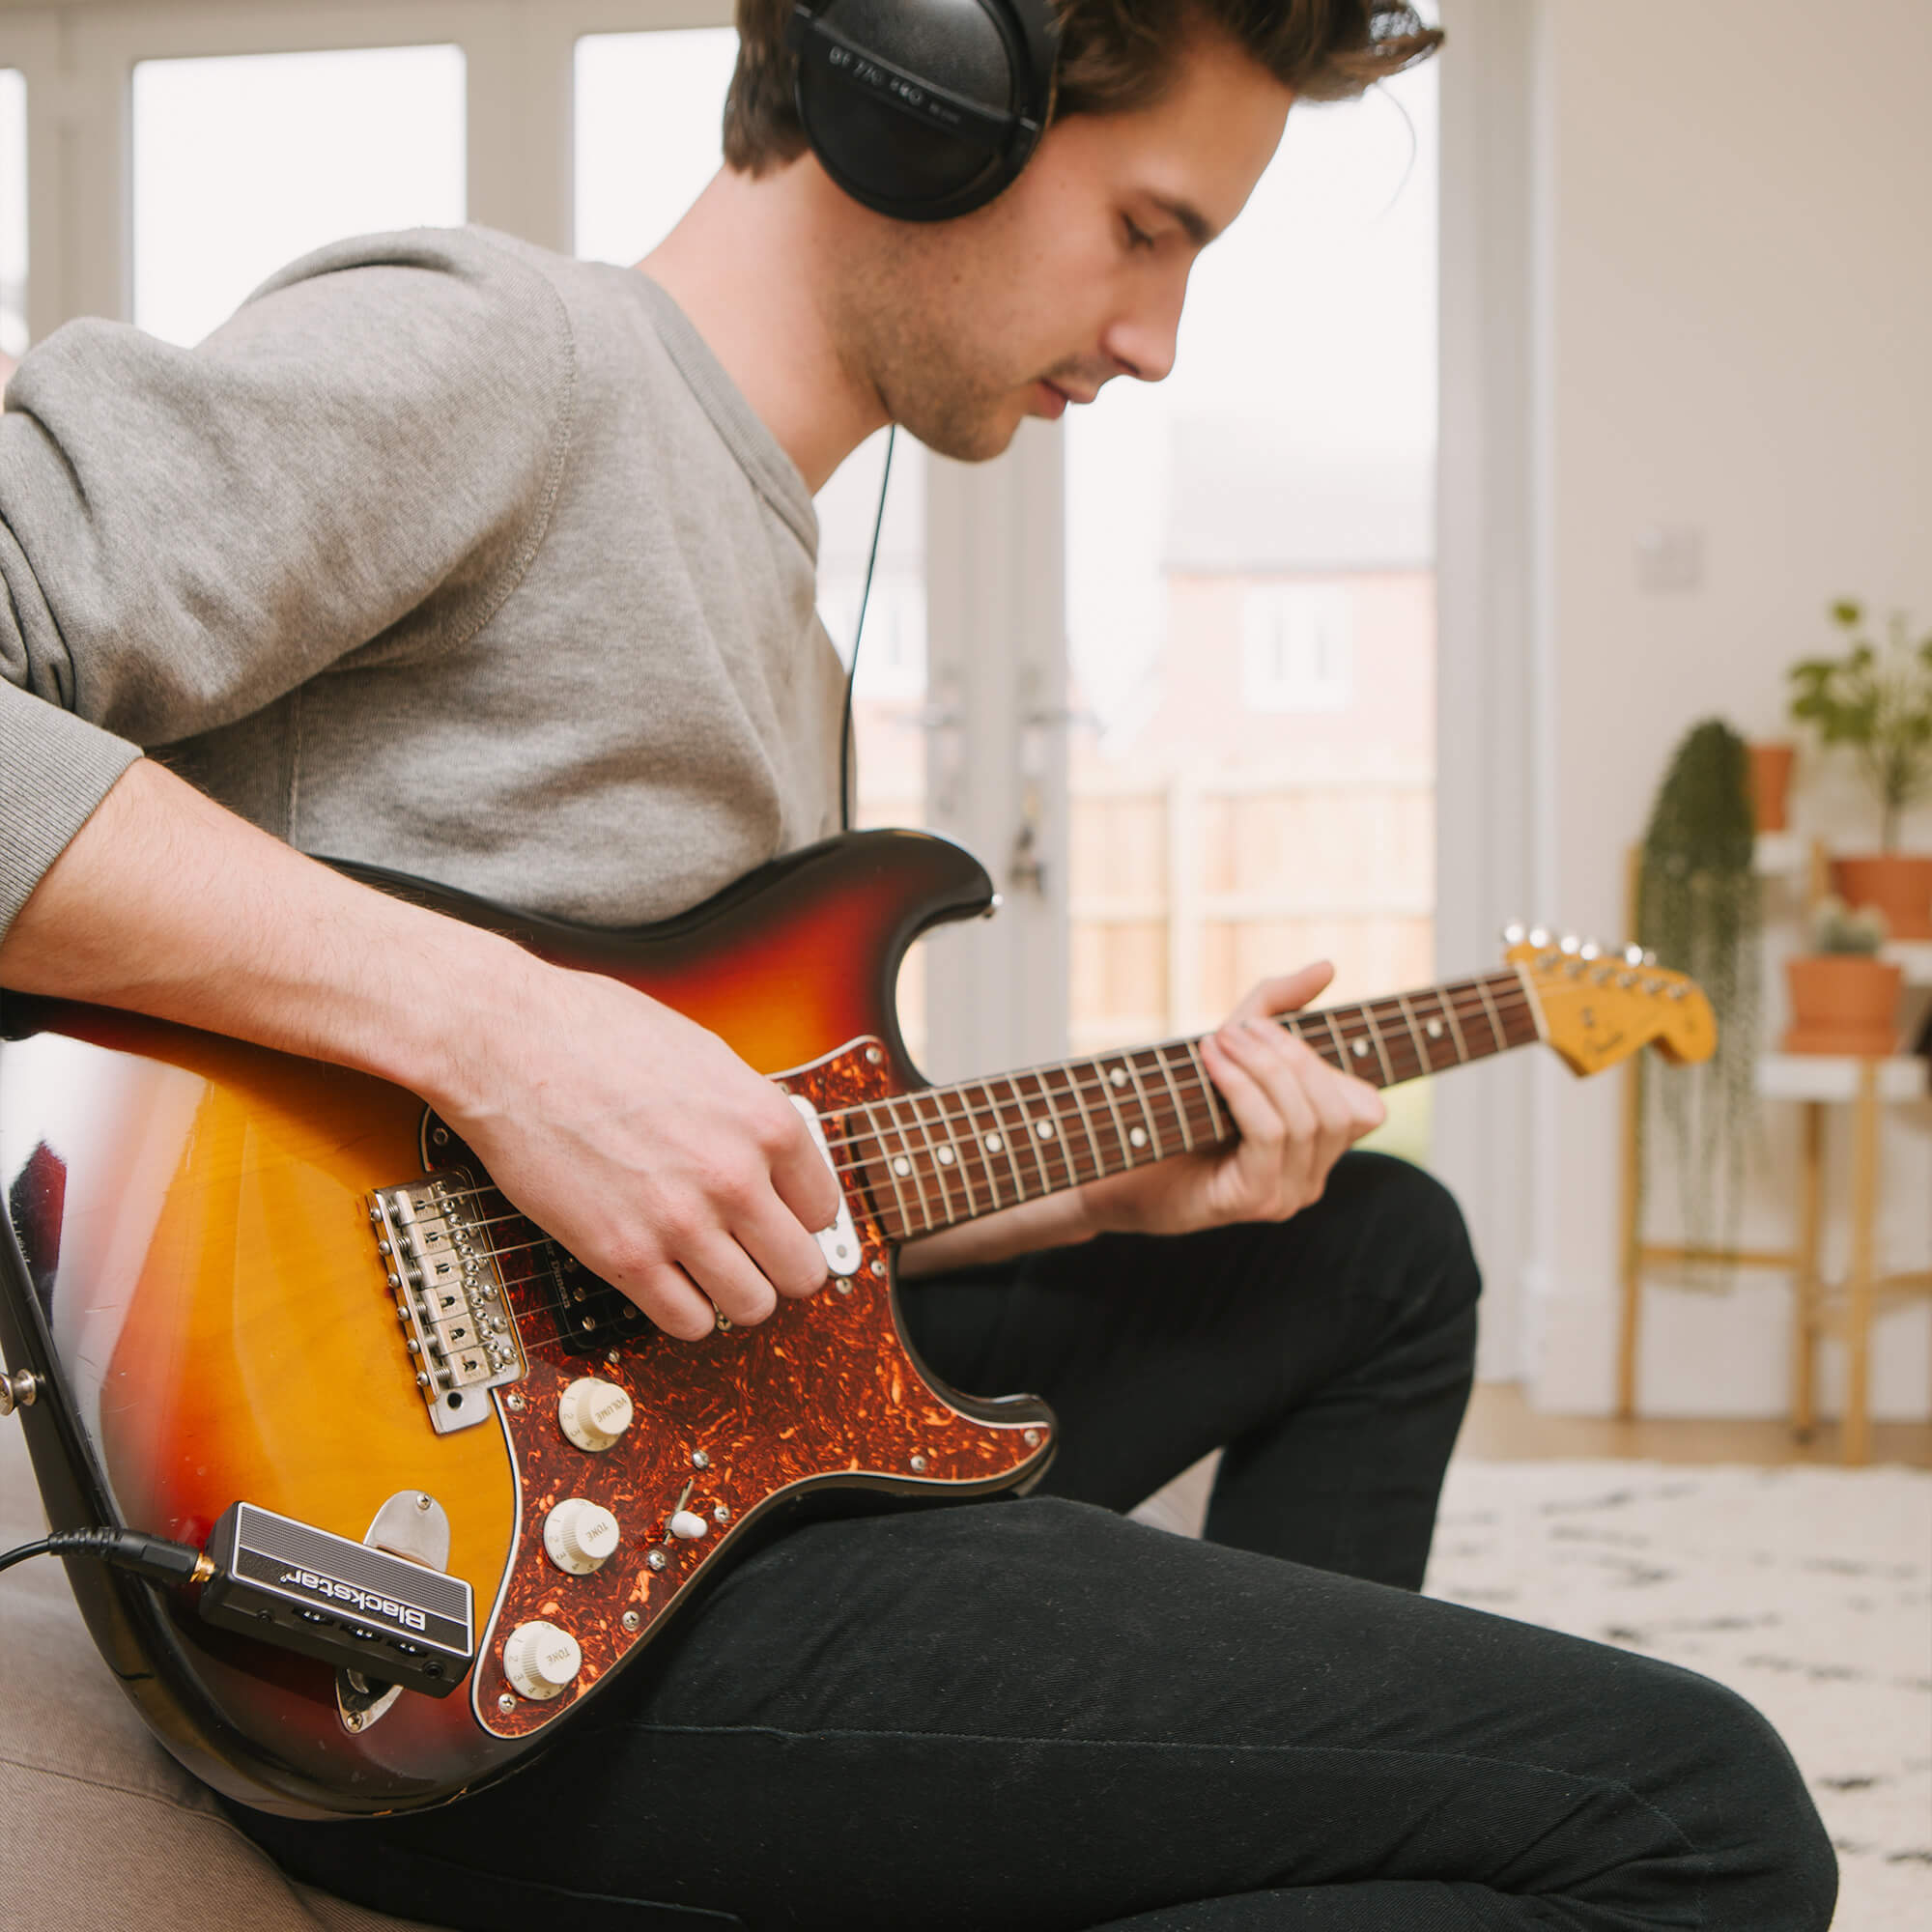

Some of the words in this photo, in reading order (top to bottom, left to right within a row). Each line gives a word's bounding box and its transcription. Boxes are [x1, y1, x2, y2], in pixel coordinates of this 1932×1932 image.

[550, 1259, 571, 1309] Duncan
[594, 1397, 627, 1422] VOLUME
[586, 1521, 609, 1542] TONE
[286, 1570, 426, 1631] Blackstar
[547, 1645, 570, 1664] TONE
